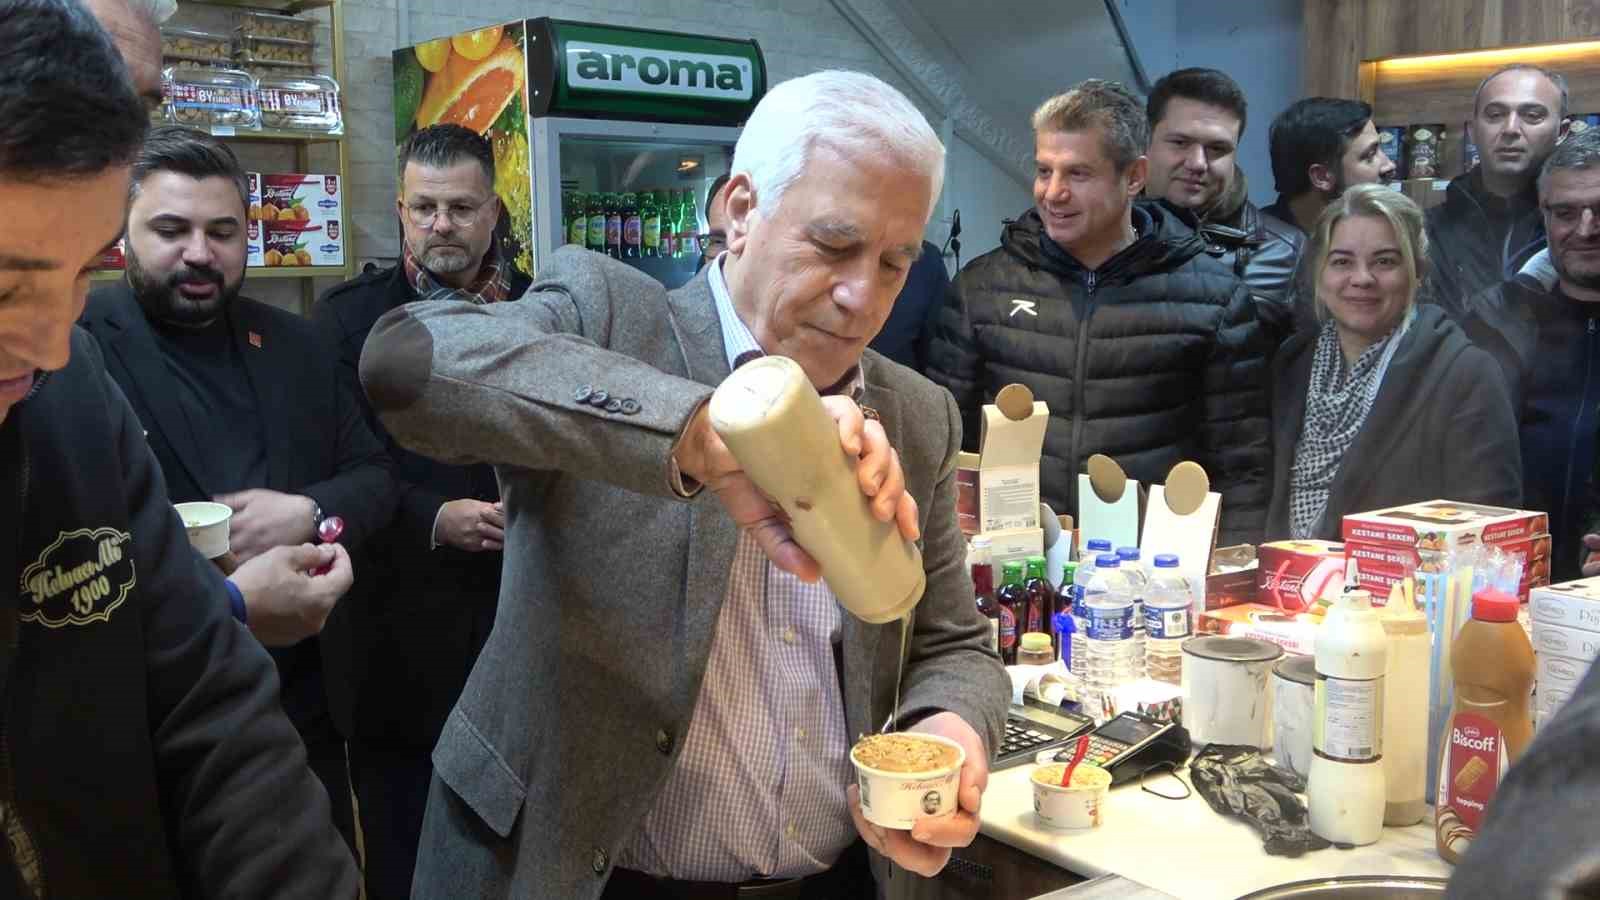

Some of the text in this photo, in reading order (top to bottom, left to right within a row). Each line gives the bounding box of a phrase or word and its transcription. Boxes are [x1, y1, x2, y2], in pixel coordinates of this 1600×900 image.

[576, 50, 744, 91] aroma
[1351, 528, 1385, 539] KESTANE
[70, 575, 110, 615] 1900
[1452, 727, 1495, 752] Biscoff
[1455, 796, 1485, 811] topping
